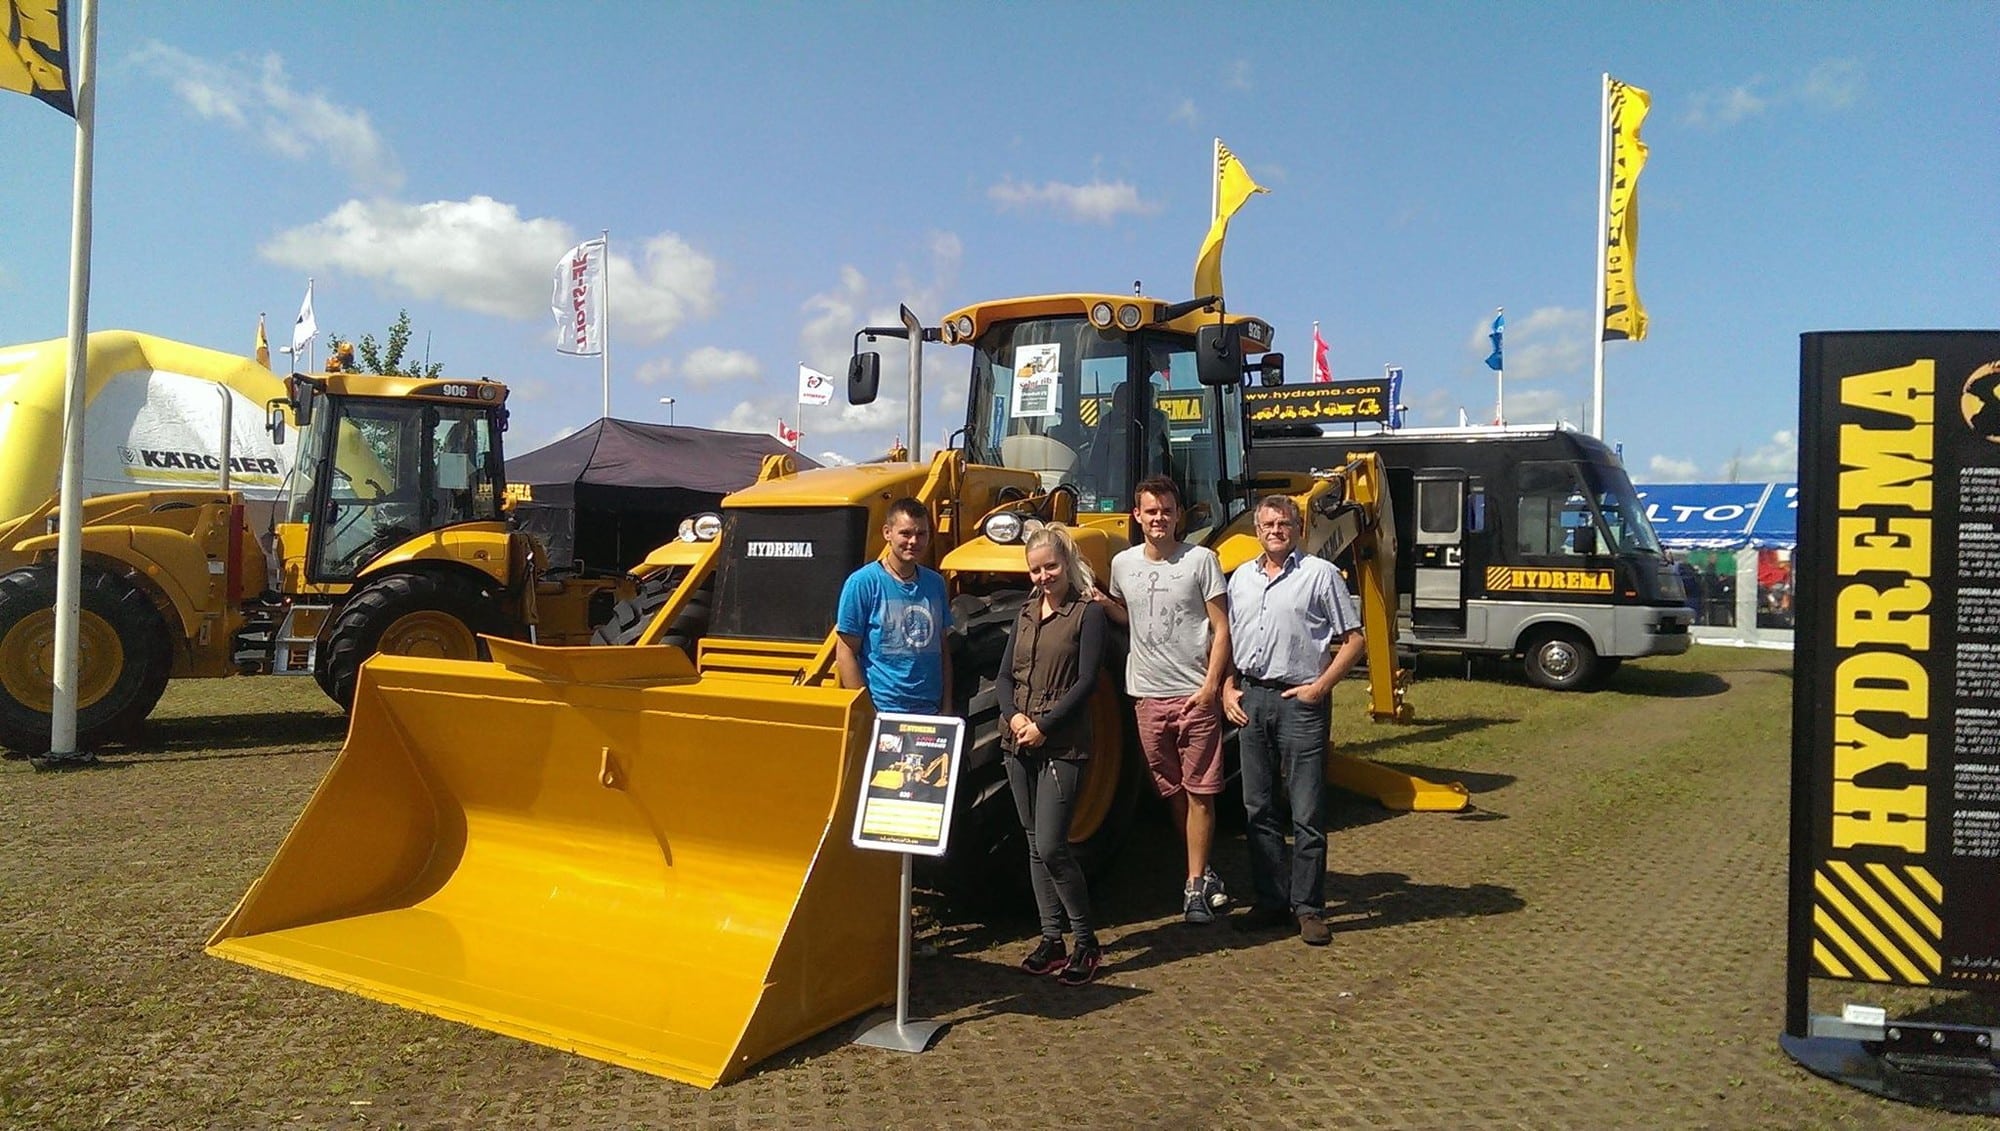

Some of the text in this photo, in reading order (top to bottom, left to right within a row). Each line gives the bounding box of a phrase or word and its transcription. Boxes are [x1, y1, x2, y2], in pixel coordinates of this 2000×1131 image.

[442, 385, 468, 397] 906
[1245, 386, 1381, 400] ww.hydrema.com
[1157, 398, 1201, 421] EMA
[141, 450, 279, 474] KÄRCHER
[506, 483, 532, 501] EMA
[1646, 503, 1746, 522] LTO
[747, 541, 813, 557] HYDREMA
[1511, 570, 1612, 590] HYDREMA
[1833, 359, 1935, 853] HYDREMA
